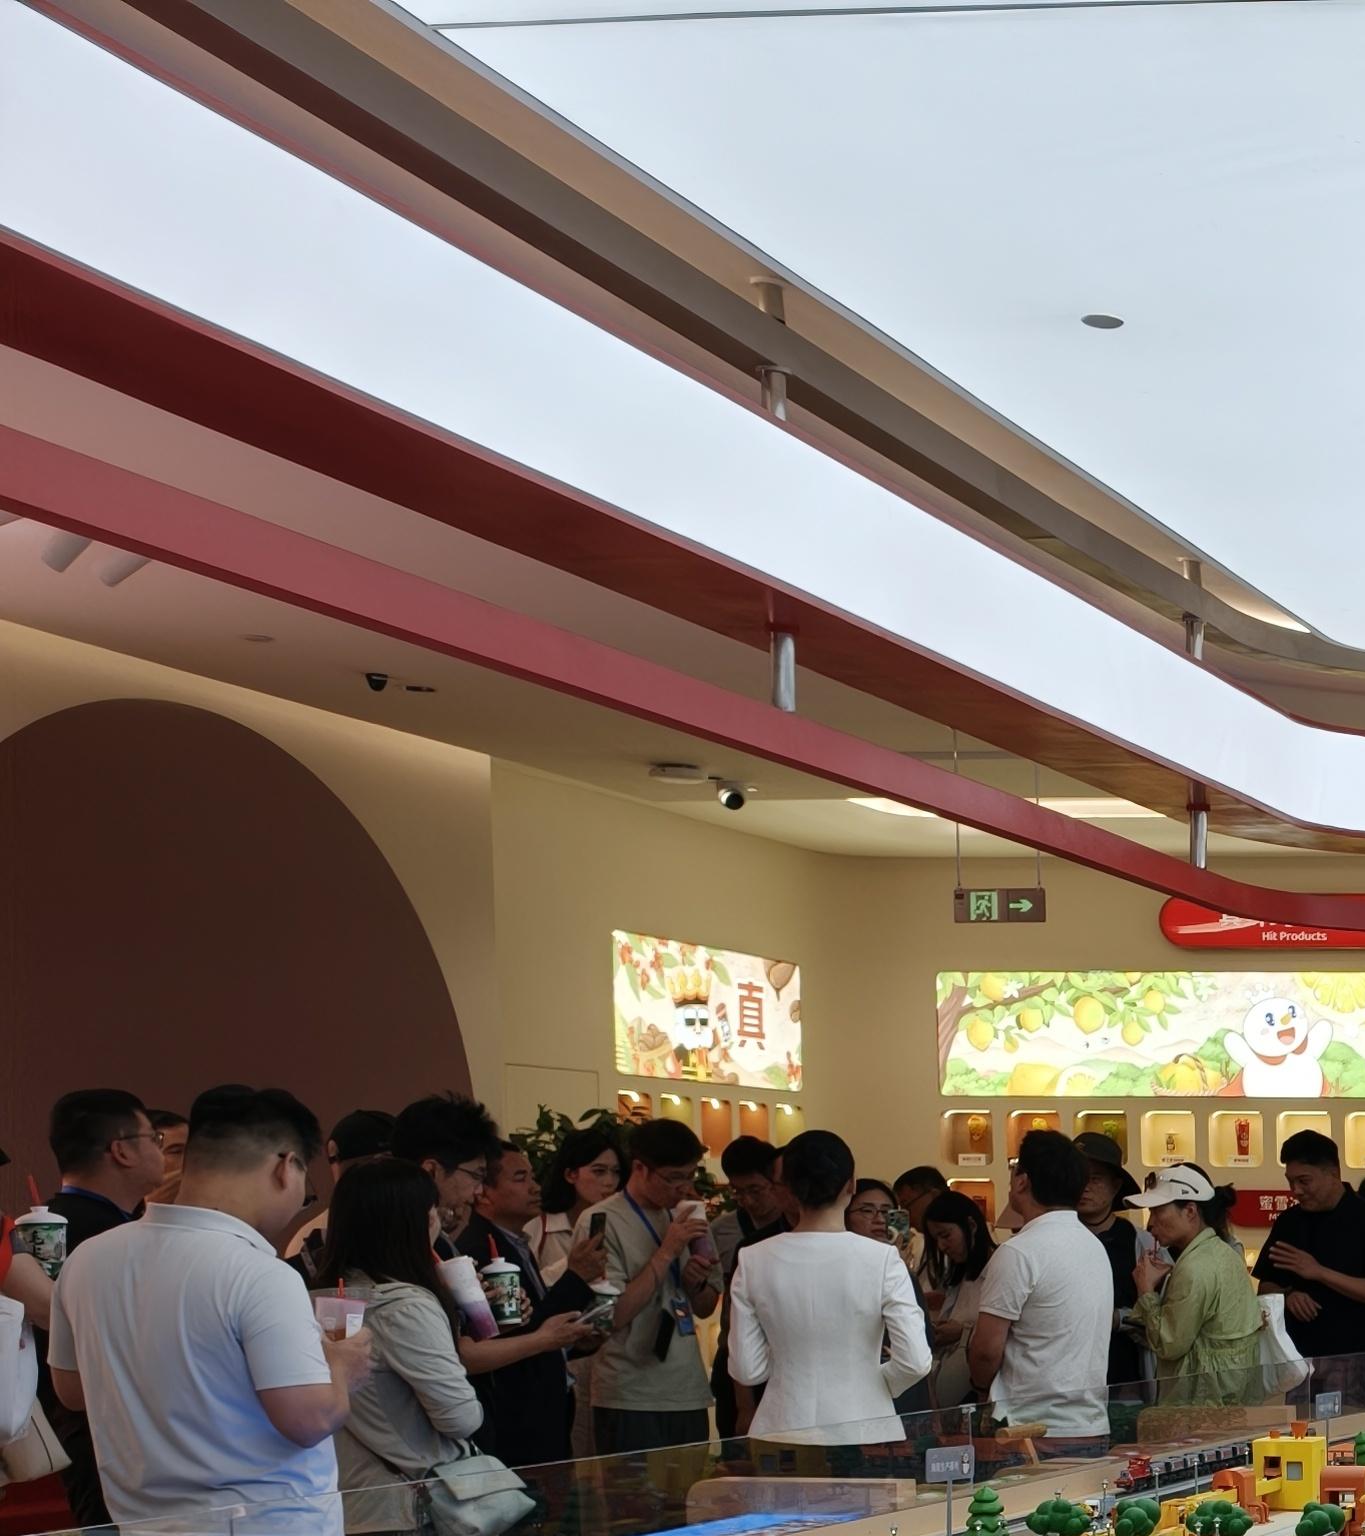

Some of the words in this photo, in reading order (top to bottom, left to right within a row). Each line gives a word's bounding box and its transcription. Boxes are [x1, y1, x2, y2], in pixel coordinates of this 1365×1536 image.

[1262, 931, 1278, 942] Hit
[1279, 931, 1328, 942] Products
[737, 981, 766, 1050] 真
